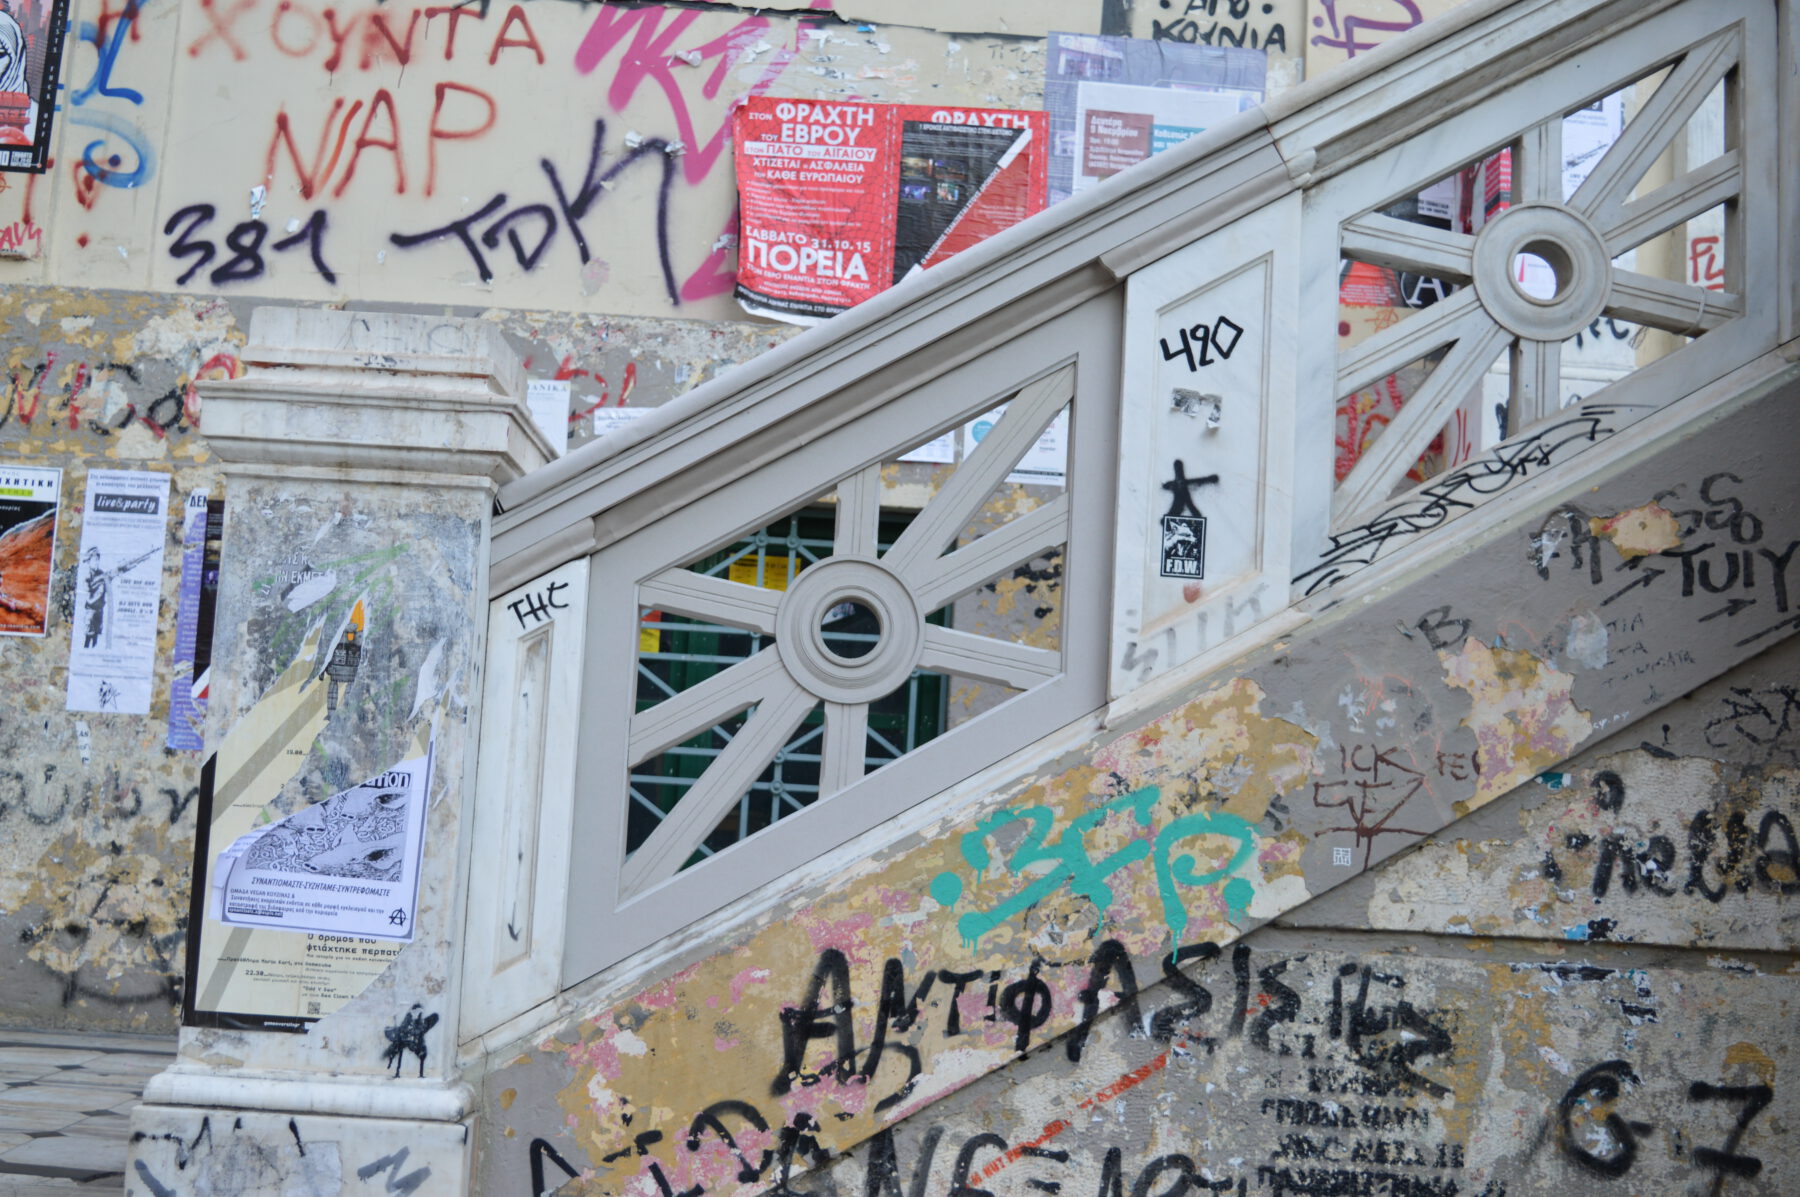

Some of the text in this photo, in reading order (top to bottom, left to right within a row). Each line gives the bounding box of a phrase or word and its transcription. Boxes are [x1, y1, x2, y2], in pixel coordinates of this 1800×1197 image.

[749, 102, 875, 127] ΣΤΟΝ ΦΡΑΧΤΗ
[932, 110, 1030, 129] ΦΡΑΧΤΗ
[761, 123, 861, 146] ΤΟΥ ΕΒΡΟΥ
[766, 144, 803, 156] ΠΑΤΟ
[823, 149, 875, 160] ΑΙΓΑΙΟΥ
[753, 157, 800, 169] ΧΤΙΖΕΤΑΙ
[809, 160, 865, 172] ΑΣΦΑΛΕΙΑ
[767, 170, 797, 180] ΚΑΘΕ
[800, 171, 863, 184] ΕΥΡΩΠΑΙΟΥ
[746, 225, 871, 253] ΣΑΒΒΑΤΟ 31.10.15
[747, 238, 870, 281] ΠΟΡΕΙΑ
[816, 277, 838, 286] ΣΤΟΝ
[1159, 315, 1244, 372] 420
[97, 495, 156, 513] live&party
[1165, 558, 1200, 575] F.D.W.
[251, 876, 391, 897] ΣΥΝΑΝΤΙΟΜΑΣΤΕ-ΣΥΖΗΤΑΜΕ-ΣΥΝΤΡΕΦΟΜΑΣΤΕ
[306, 944, 357, 955] φτιάχτηκε
